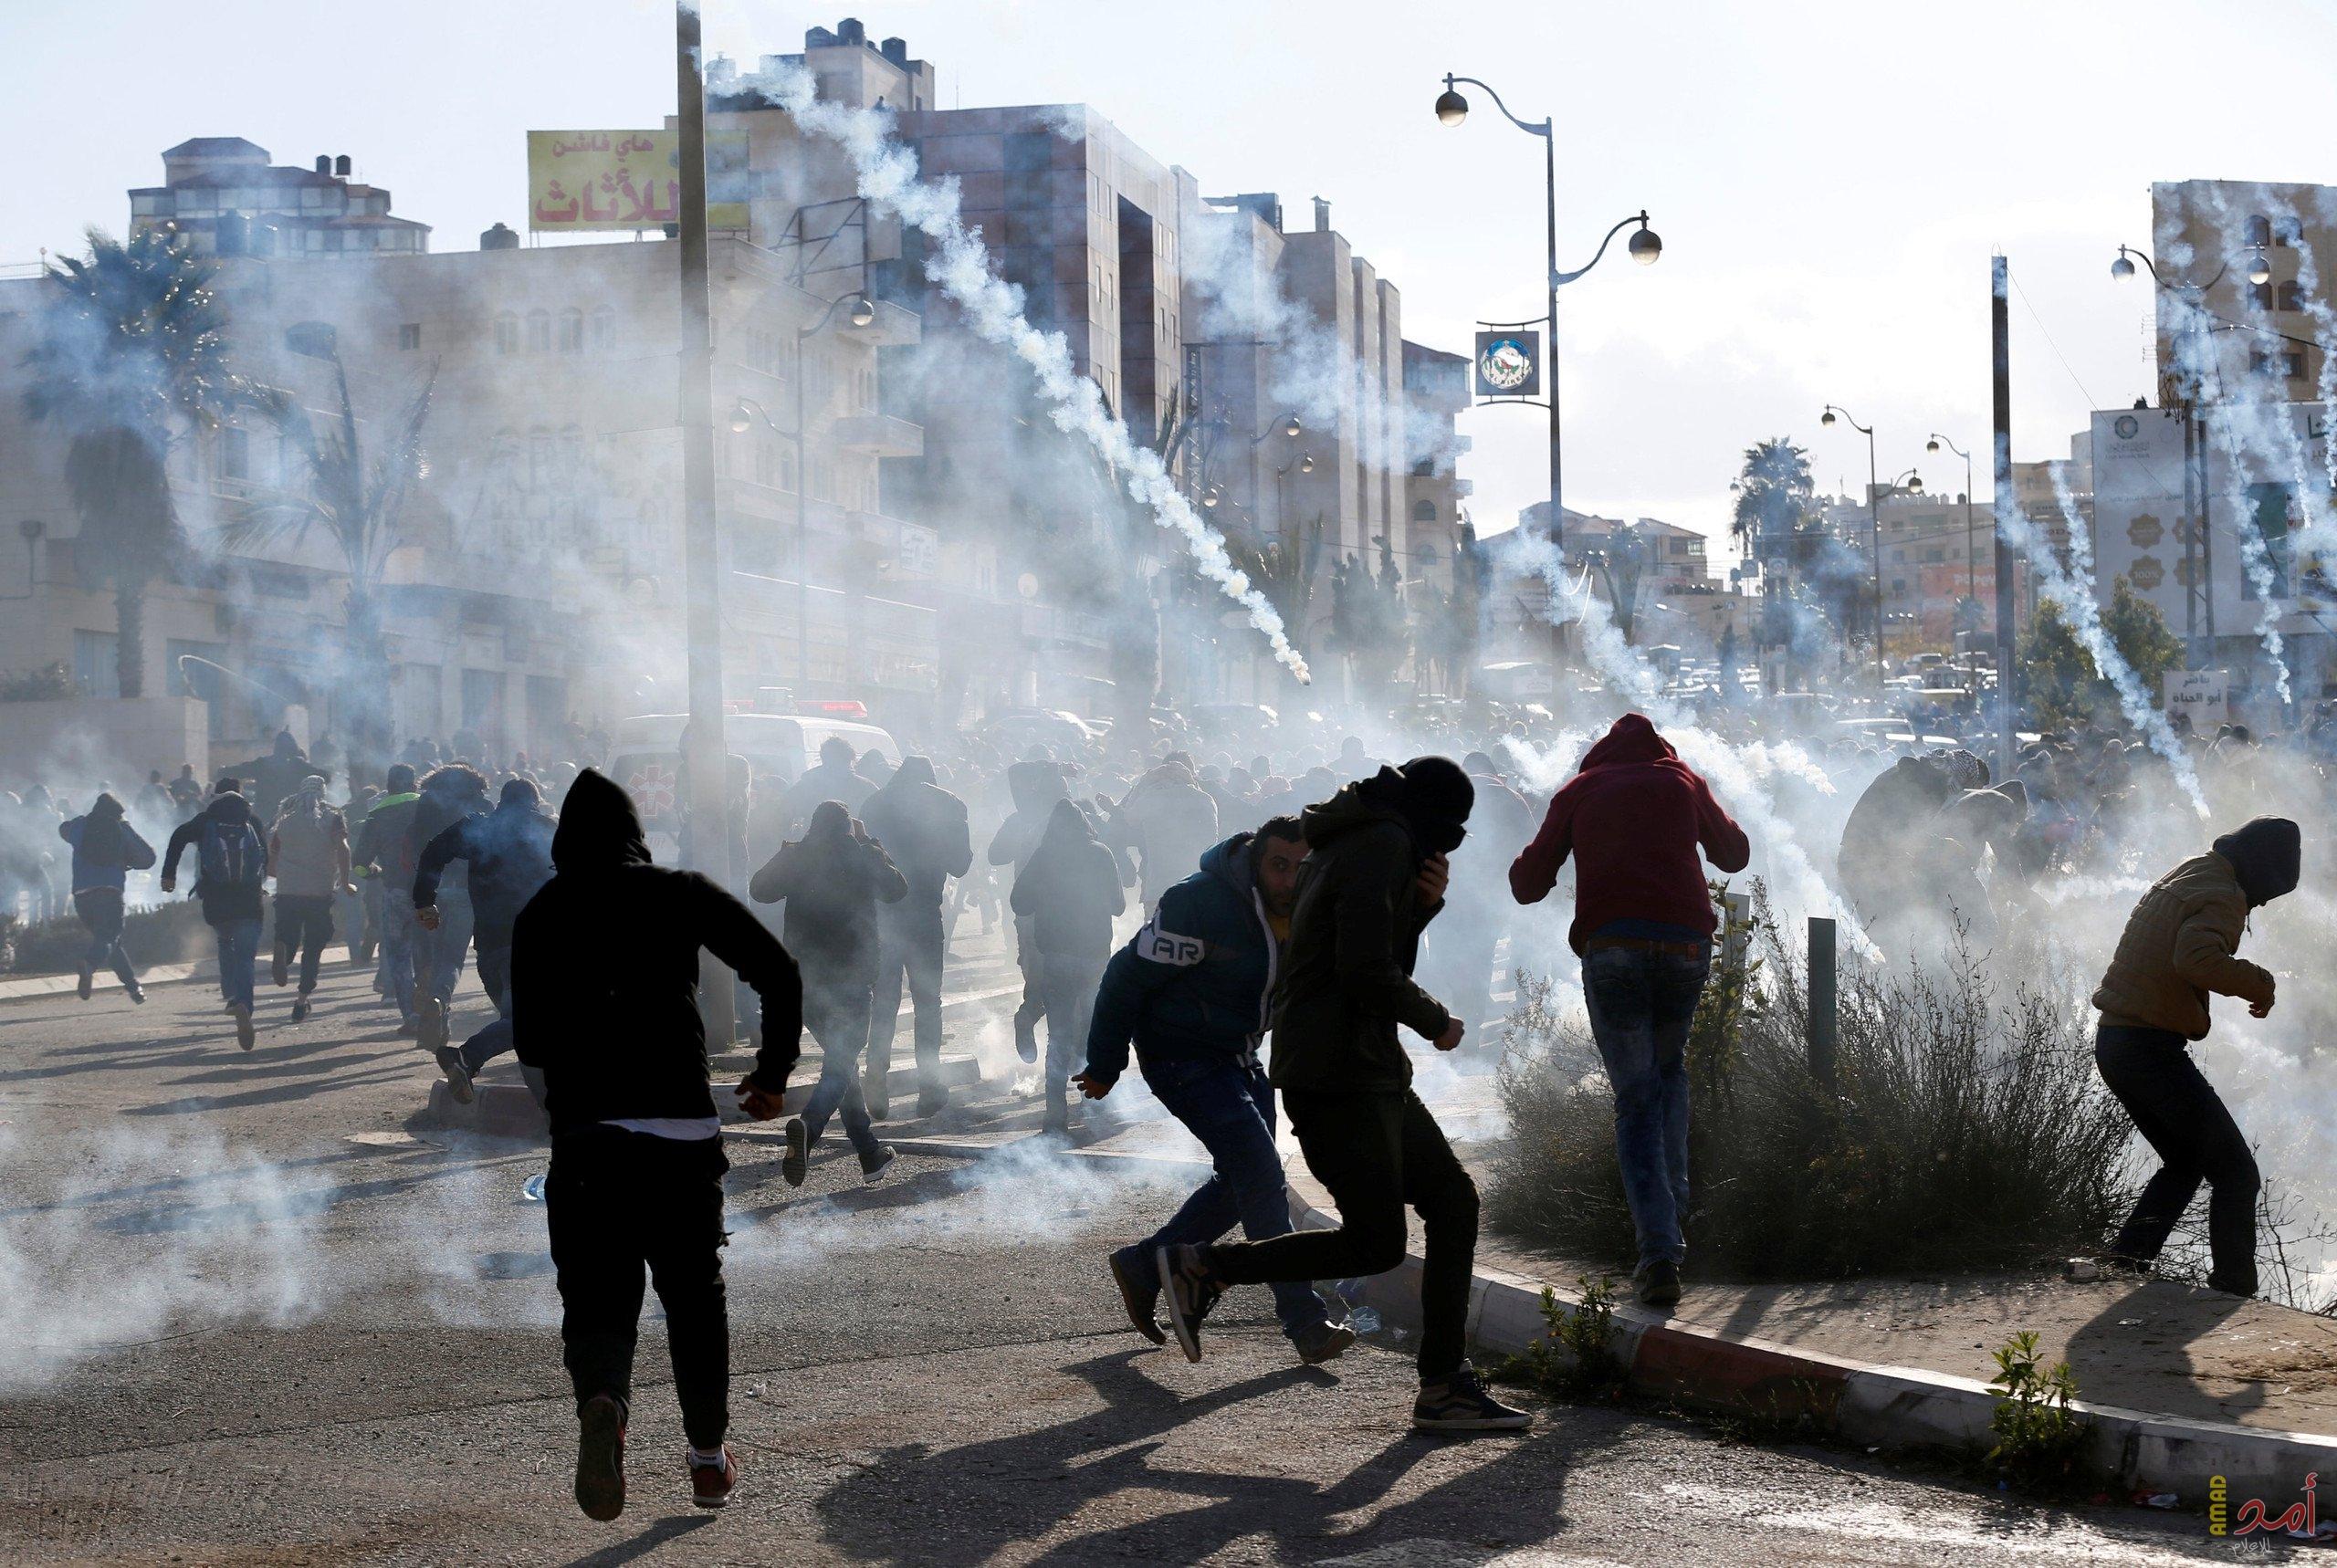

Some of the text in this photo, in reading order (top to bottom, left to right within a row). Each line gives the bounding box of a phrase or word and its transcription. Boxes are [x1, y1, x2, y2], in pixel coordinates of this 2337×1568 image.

[552, 133, 654, 162] هاي فاشن
[535, 168, 679, 223] للأثاث
